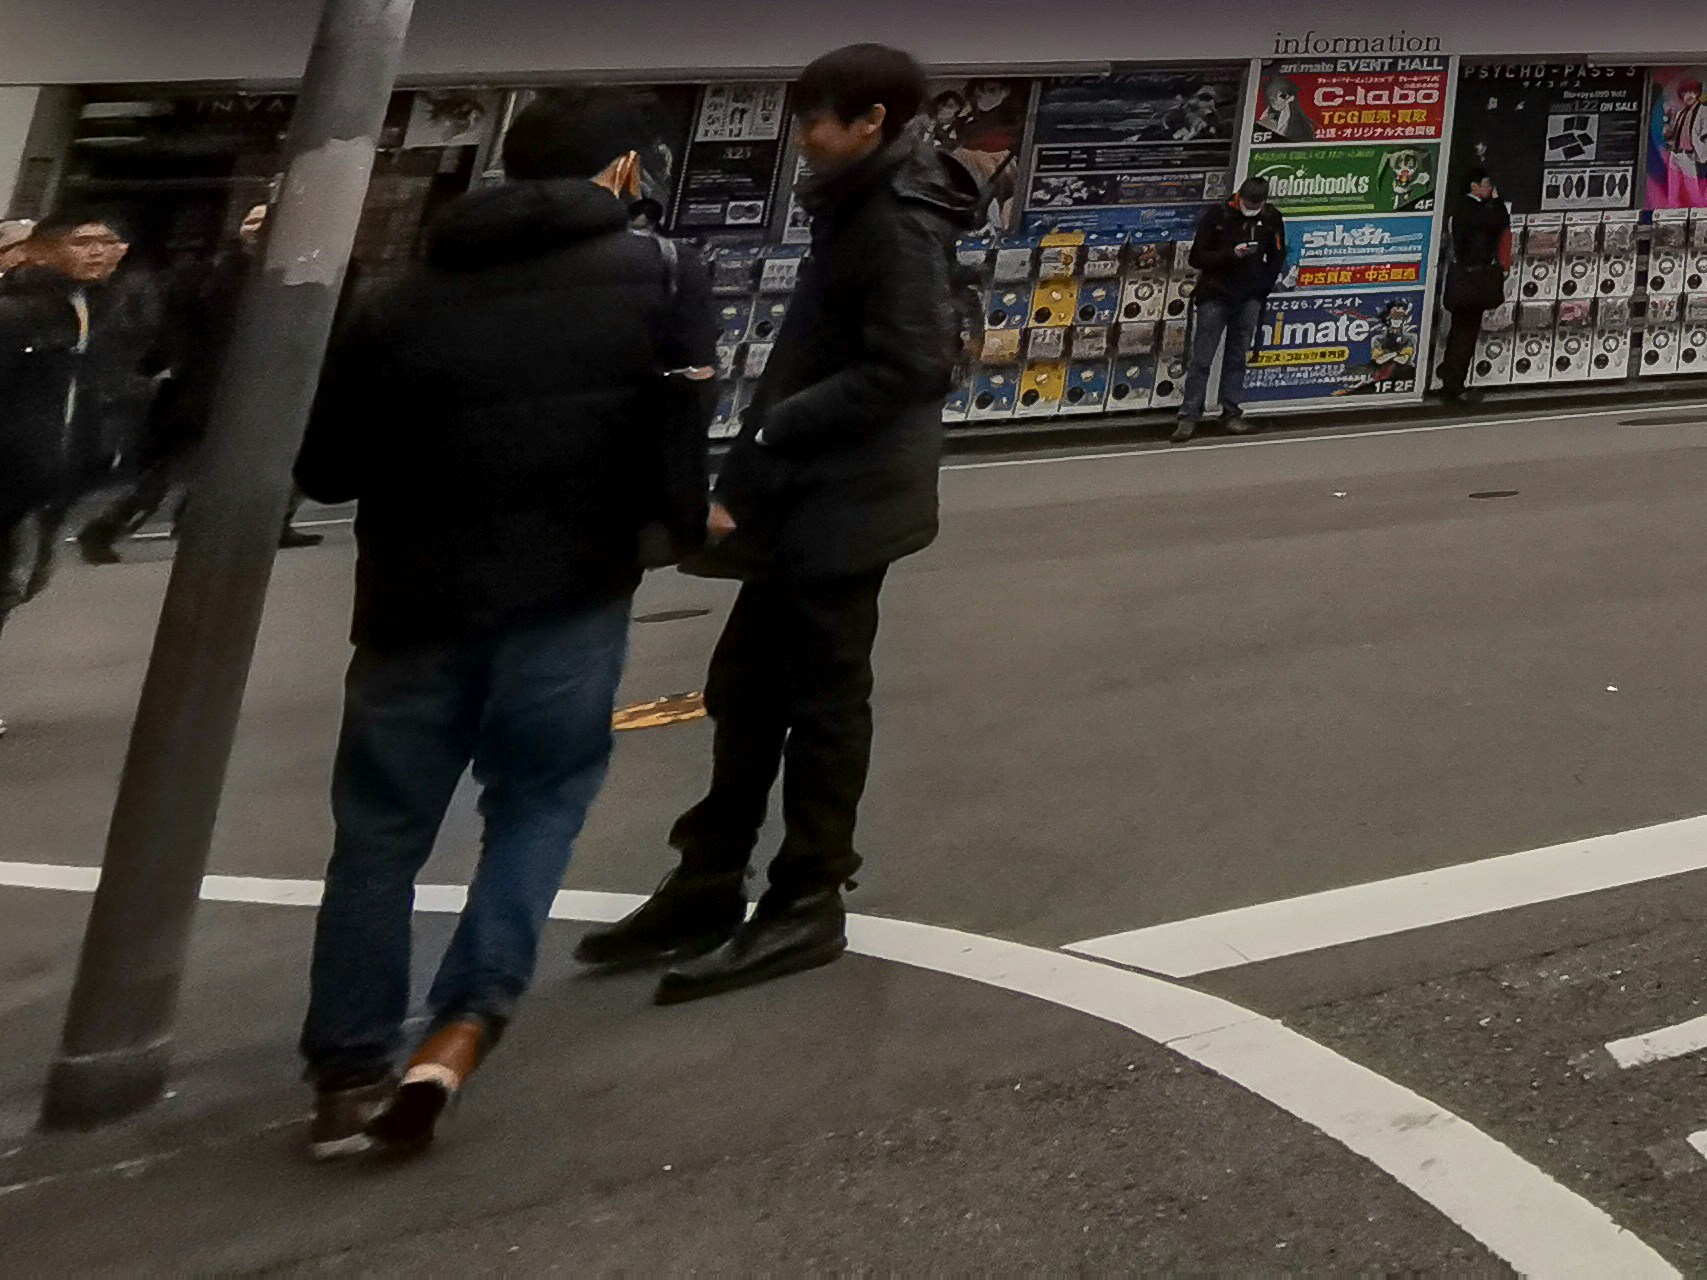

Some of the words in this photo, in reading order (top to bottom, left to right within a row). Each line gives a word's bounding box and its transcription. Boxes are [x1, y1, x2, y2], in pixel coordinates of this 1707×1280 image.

[1273, 30, 1442, 56] information
[1336, 58, 1394, 73] EVENT
[1396, 56, 1444, 71] HALL
[1312, 85, 1441, 108] C-labo
